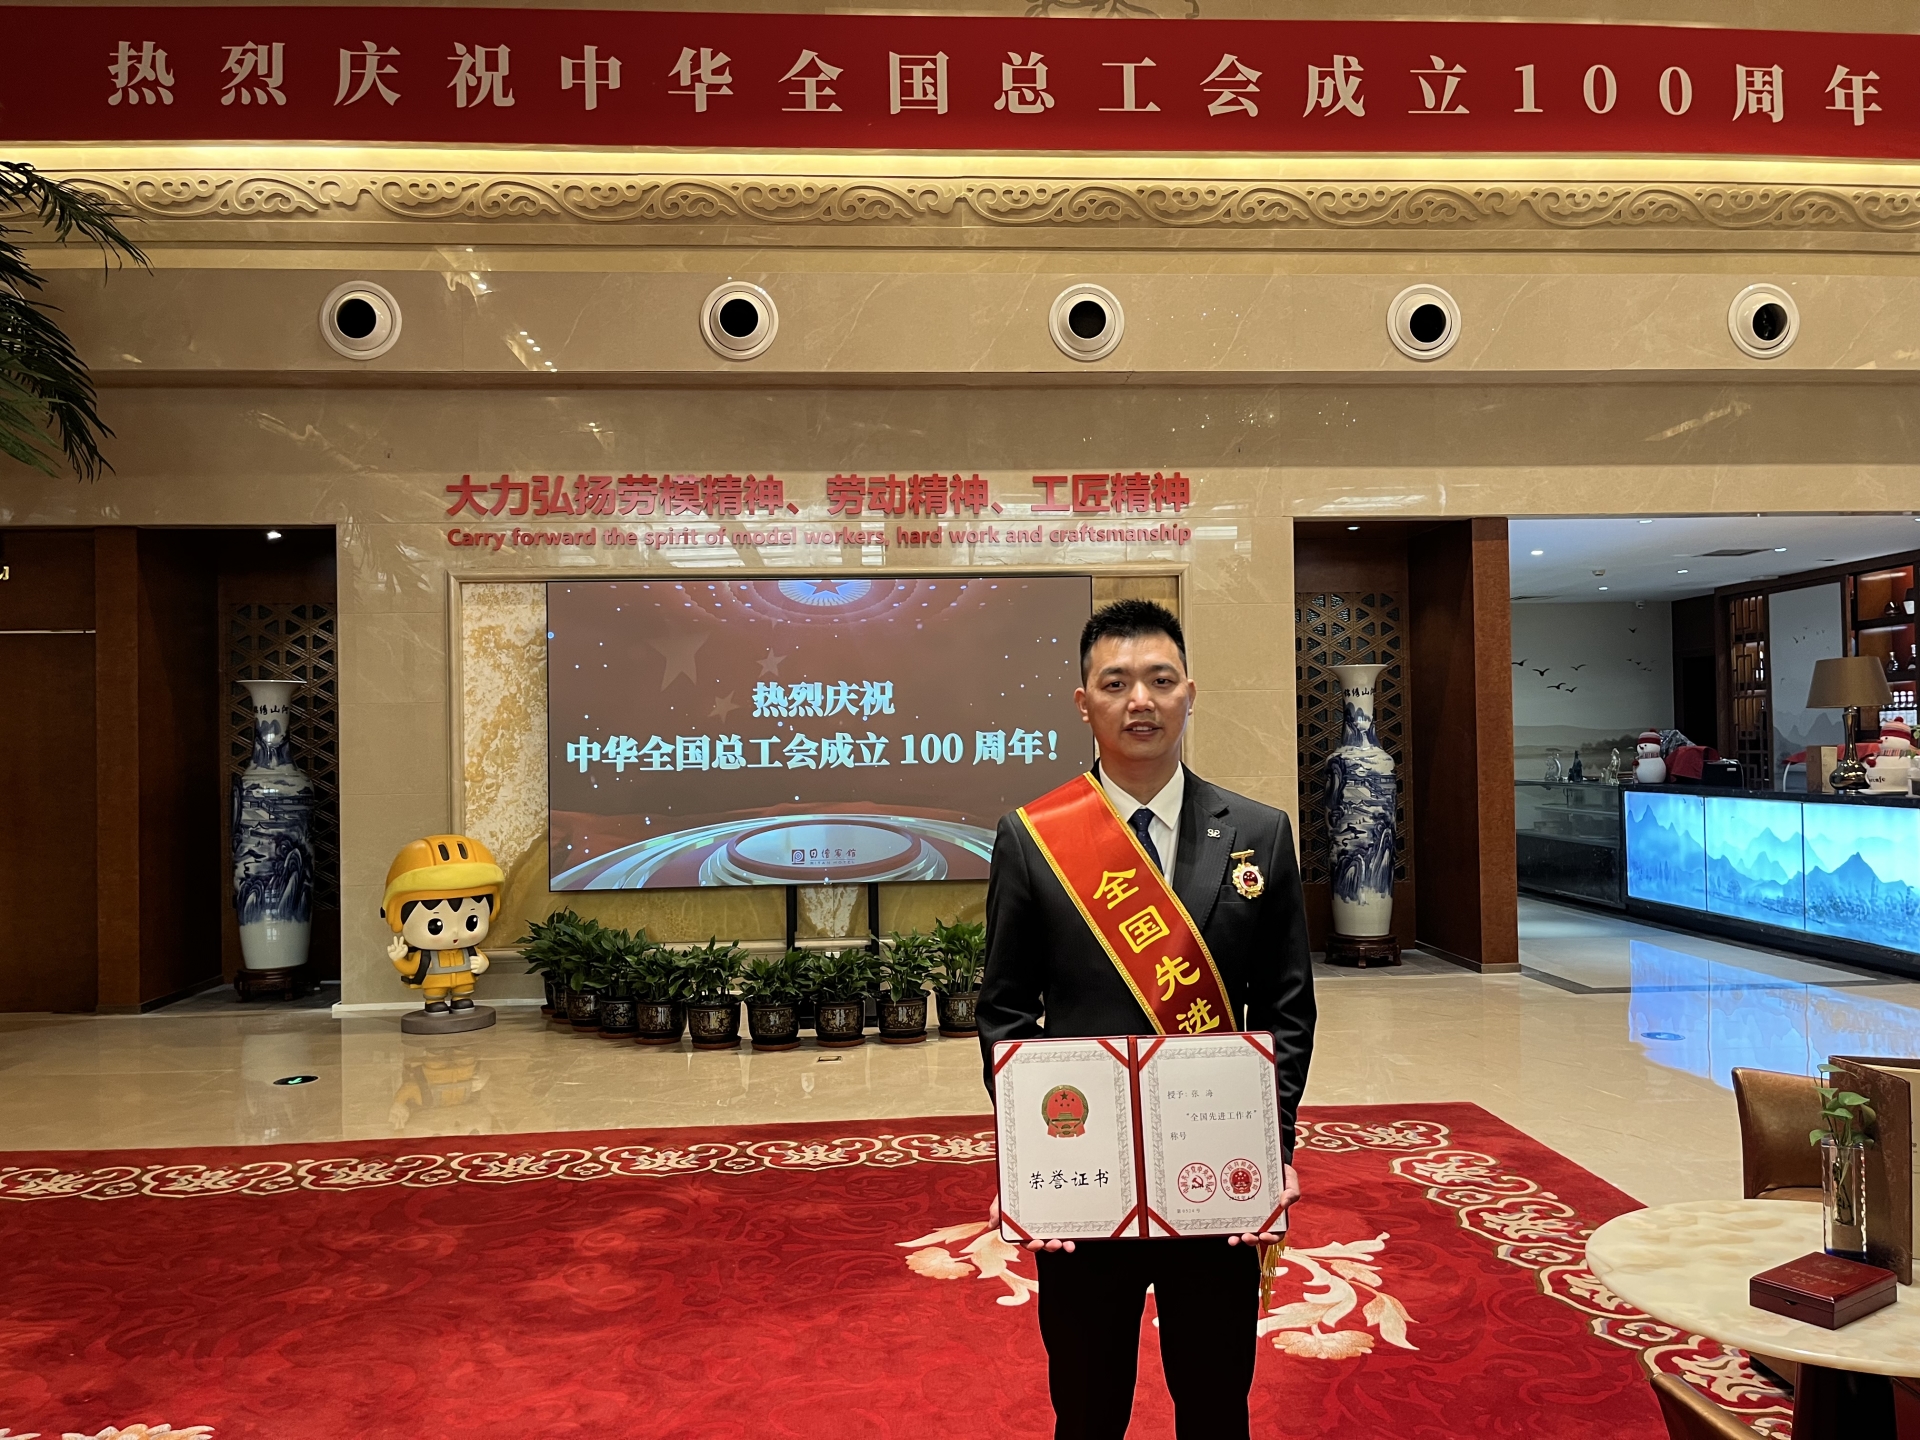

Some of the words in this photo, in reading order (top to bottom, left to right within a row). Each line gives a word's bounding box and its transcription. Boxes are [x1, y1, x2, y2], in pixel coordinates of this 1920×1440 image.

[107, 41, 1883, 126] 热烈庆祝中华全国总工会成立100周年
[445, 472, 1191, 517] 大力弘扬劳模精神、劳动精神、工匠精神
[447, 528, 505, 550] Carry
[511, 527, 597, 546] forward
[603, 527, 637, 545] the
[644, 527, 699, 549] spirit
[704, 527, 727, 545] of
[731, 527, 798, 545] model
[803, 527, 890, 546] workers,
[896, 526, 943, 545] hard
[949, 526, 1000, 544] work
[1005, 525, 1044, 543] and
[1049, 524, 1192, 545] craftsmanship
[752, 679, 896, 718] 热烈庆祝
[1093, 867, 1220, 1034] 全国先进
[1170, 1131, 1187, 1141] 称号
[1029, 1168, 1109, 1190] 荣誉证书
